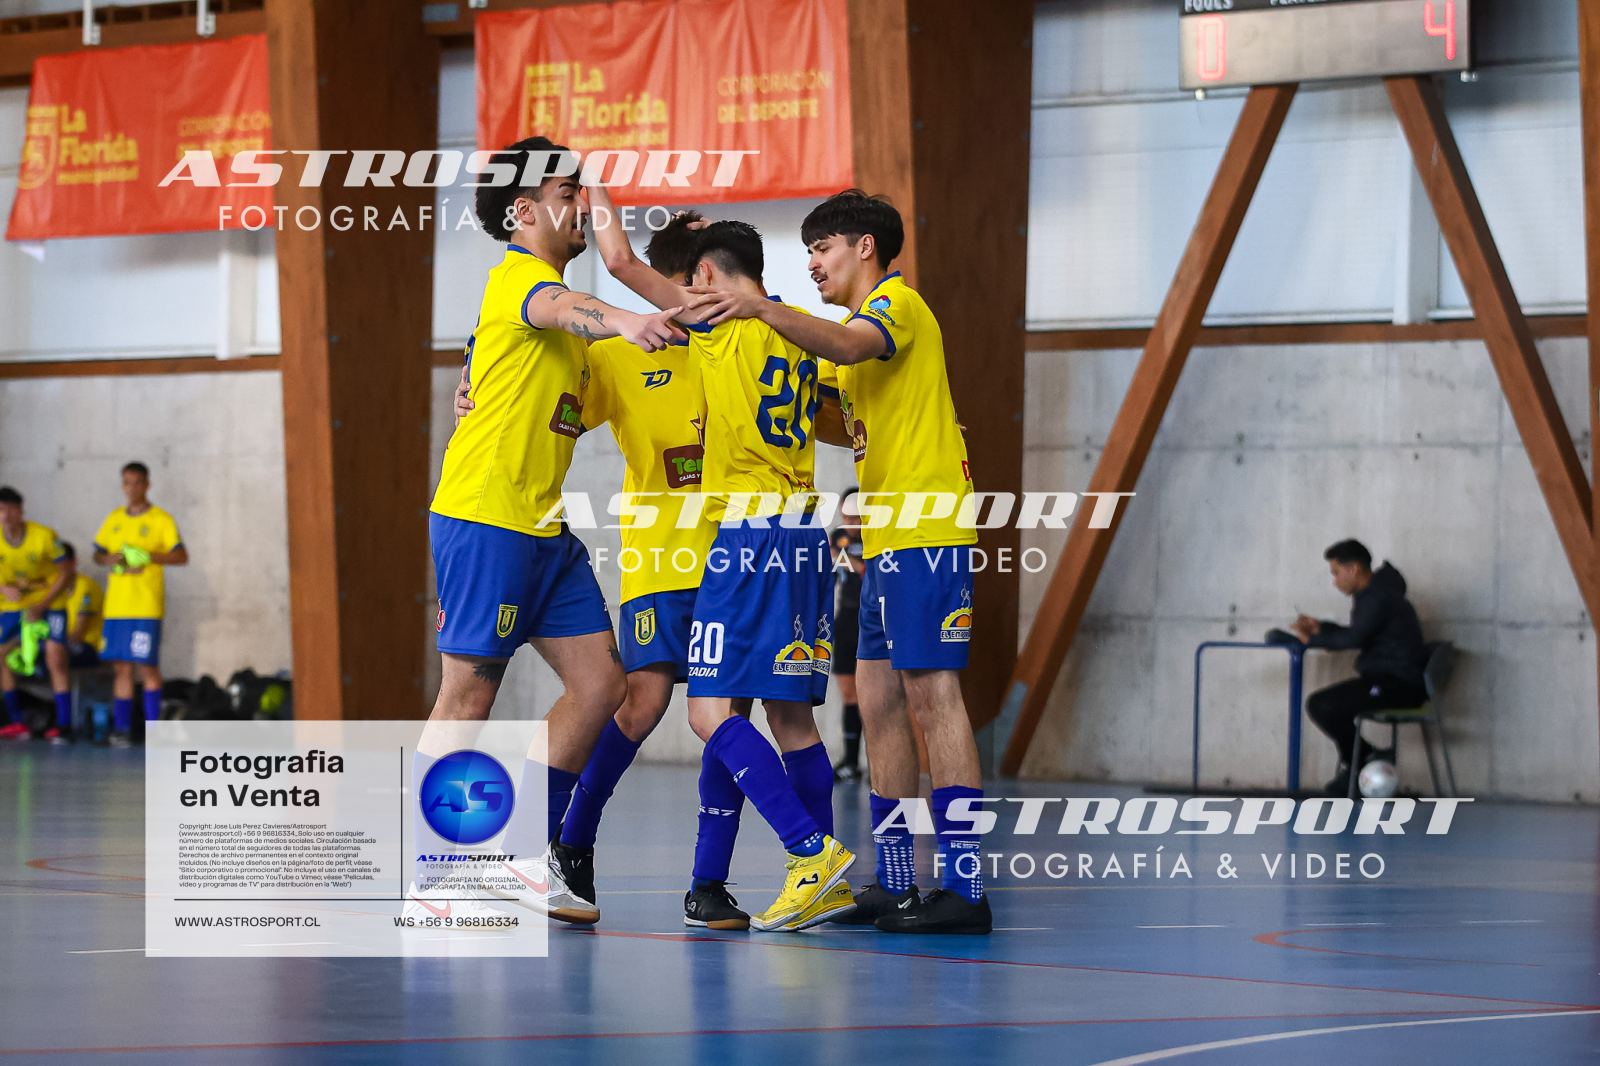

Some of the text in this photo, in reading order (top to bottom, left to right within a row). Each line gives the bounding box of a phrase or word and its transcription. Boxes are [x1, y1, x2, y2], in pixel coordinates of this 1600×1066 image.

[574, 63, 605, 93] La
[61, 104, 87, 132] La
[688, 620, 725, 664] 20
